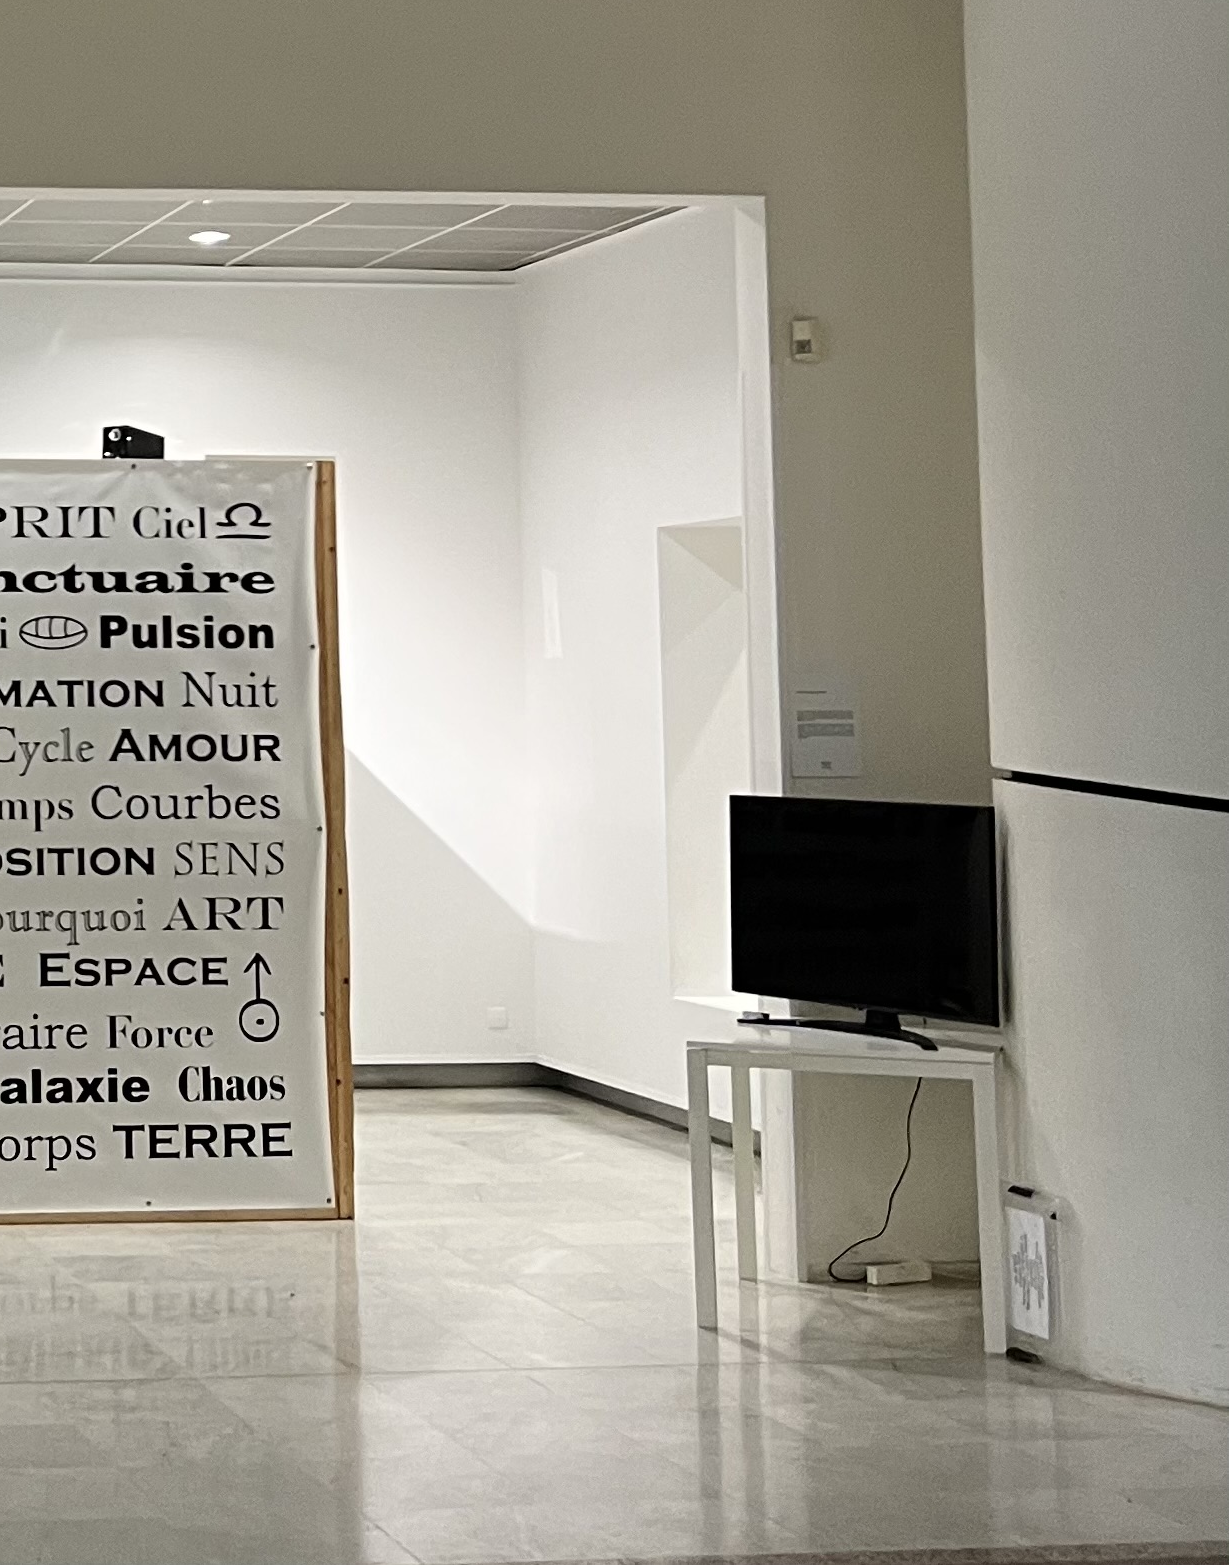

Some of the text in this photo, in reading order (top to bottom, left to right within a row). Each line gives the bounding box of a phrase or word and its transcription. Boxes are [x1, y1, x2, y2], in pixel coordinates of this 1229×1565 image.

[132, 506, 207, 540] Ciel
[99, 614, 275, 650] Pulsion
[180, 671, 279, 708] Nuit
[108, 728, 282, 763] AMOUR
[91, 783, 281, 820] Courbes
[174, 840, 285, 877] SENS
[161, 896, 284, 931] ART
[38, 952, 229, 988] ESPACE
[107, 1014, 214, 1049] Force
[178, 1065, 286, 1103] Chaos
[112, 1121, 293, 1160] TERRE
